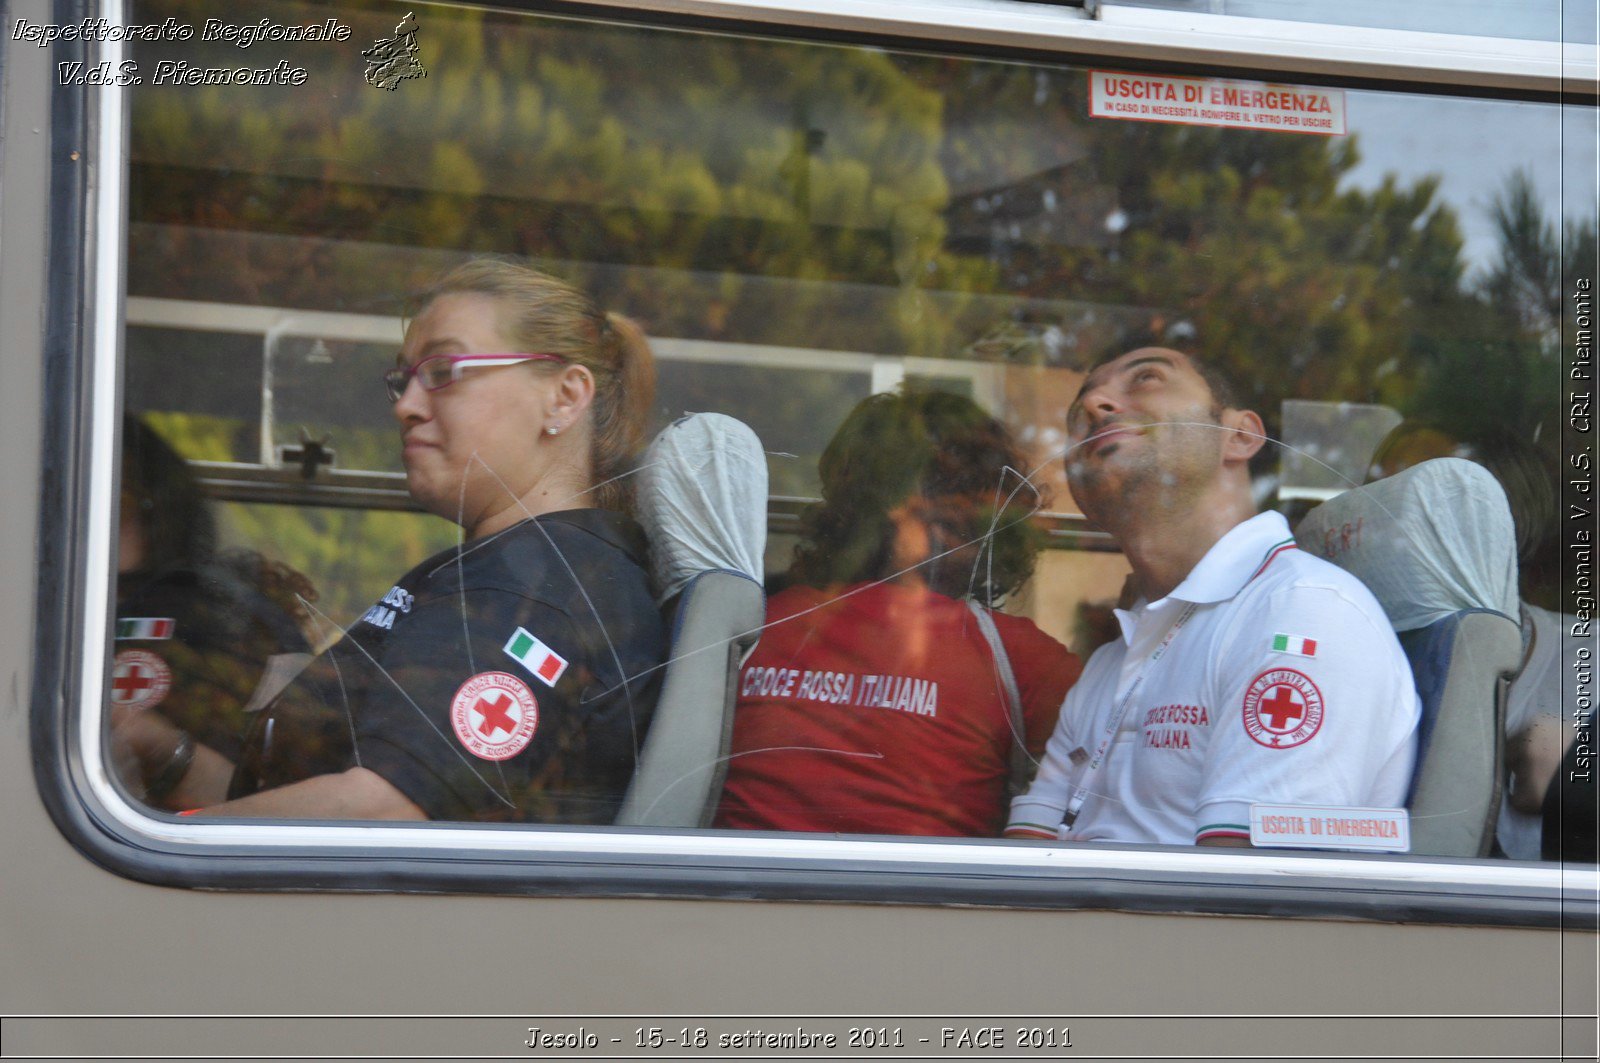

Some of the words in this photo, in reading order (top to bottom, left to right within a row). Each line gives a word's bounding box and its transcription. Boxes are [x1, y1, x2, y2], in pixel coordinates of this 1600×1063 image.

[1105, 78, 1177, 102] USCITA
[1184, 85, 1204, 103] DI
[1210, 87, 1332, 114] EMERGENZA
[1104, 102, 1113, 111] IN
[1115, 103, 1138, 114] CASO
[1141, 105, 1150, 115] DI
[1152, 105, 1199, 118] NECESSITÀ
[1200, 109, 1241, 122] ROMPERE
[1243, 112, 1252, 122] IL
[1254, 113, 1282, 125] VETRO
[1284, 116, 1300, 127] PER
[1301, 117, 1332, 129] USCIRE
[742, 667, 798, 697] CROCE
[797, 670, 854, 704] ROSSA
[855, 674, 938, 717] ITALIANA
[1167, 704, 1209, 726] ROSSA
[1261, 815, 1305, 834] USCITA
[1309, 817, 1322, 835] DI
[1326, 817, 1399, 838] EMERGENZA
